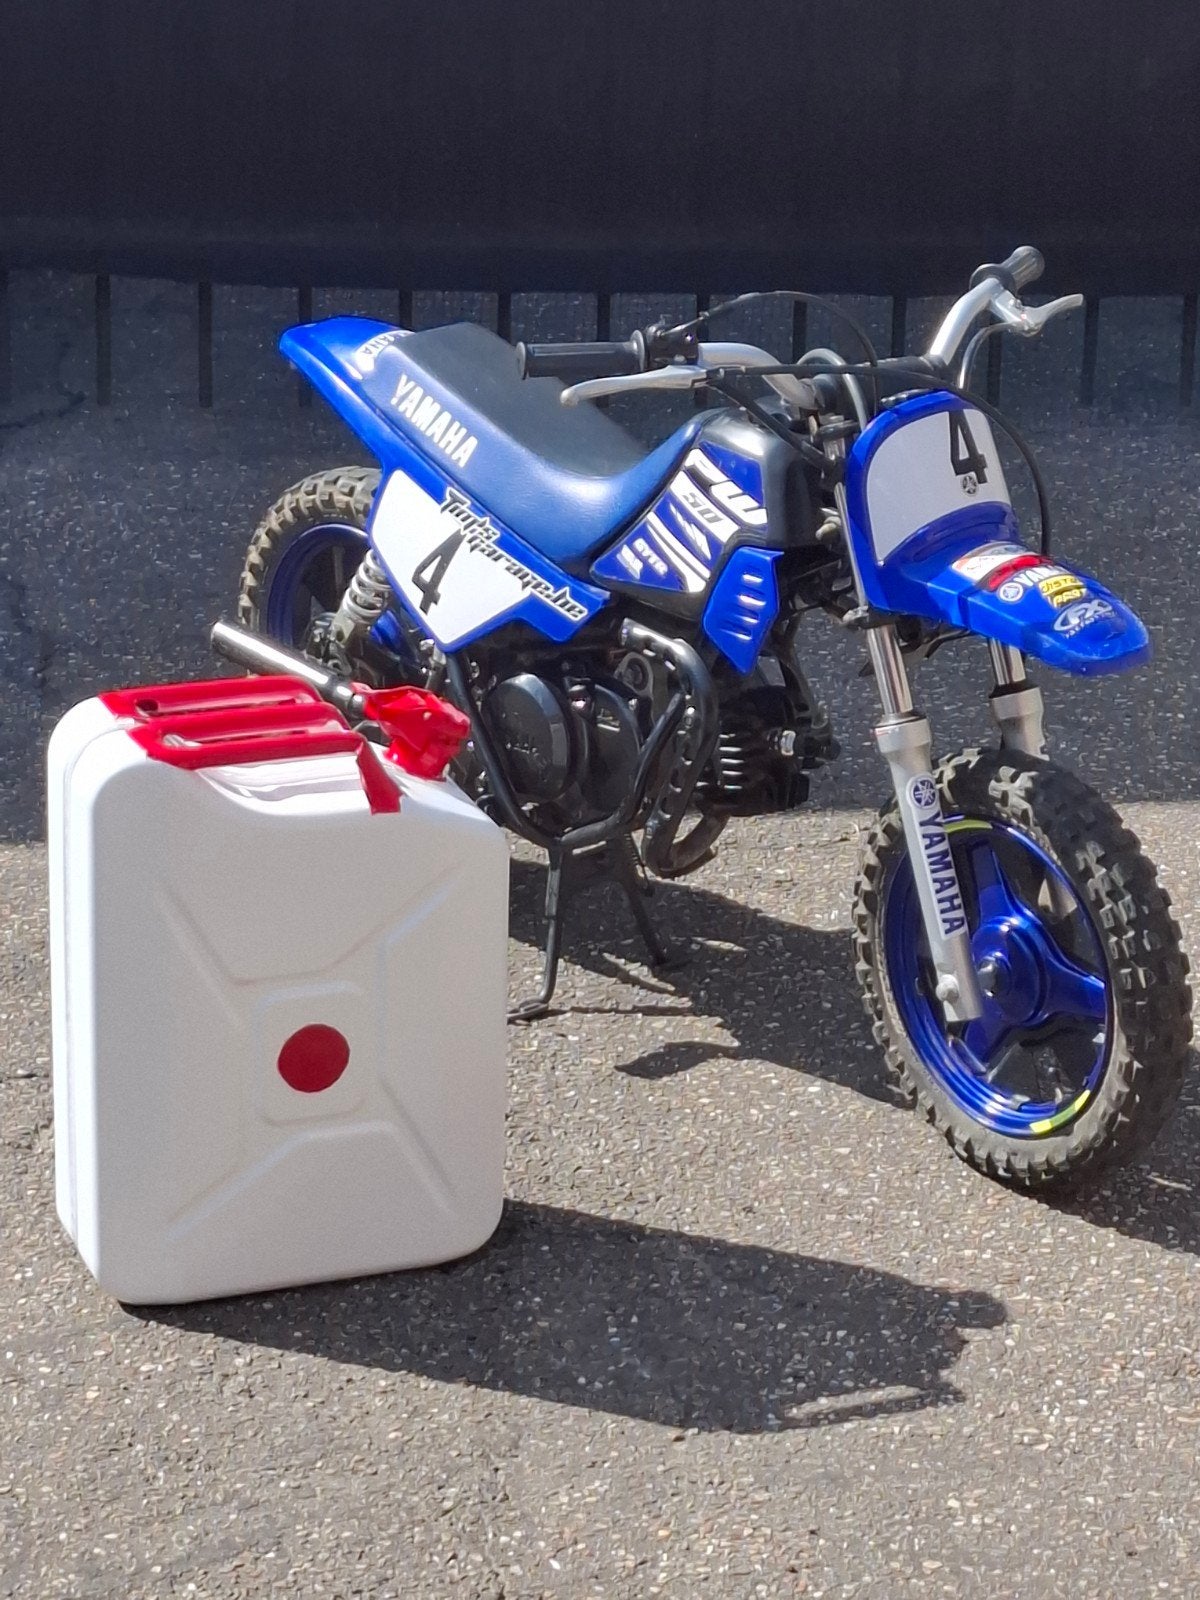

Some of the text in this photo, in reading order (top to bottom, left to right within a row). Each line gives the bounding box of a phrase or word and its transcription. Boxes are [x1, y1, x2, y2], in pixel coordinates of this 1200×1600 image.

[391, 374, 478, 468] YAMAHA
[948, 408, 988, 485] 4
[682, 492, 723, 524] 50
[684, 449, 768, 525] PW
[411, 527, 467, 616] 4
[918, 809, 965, 935] YAMAHA
